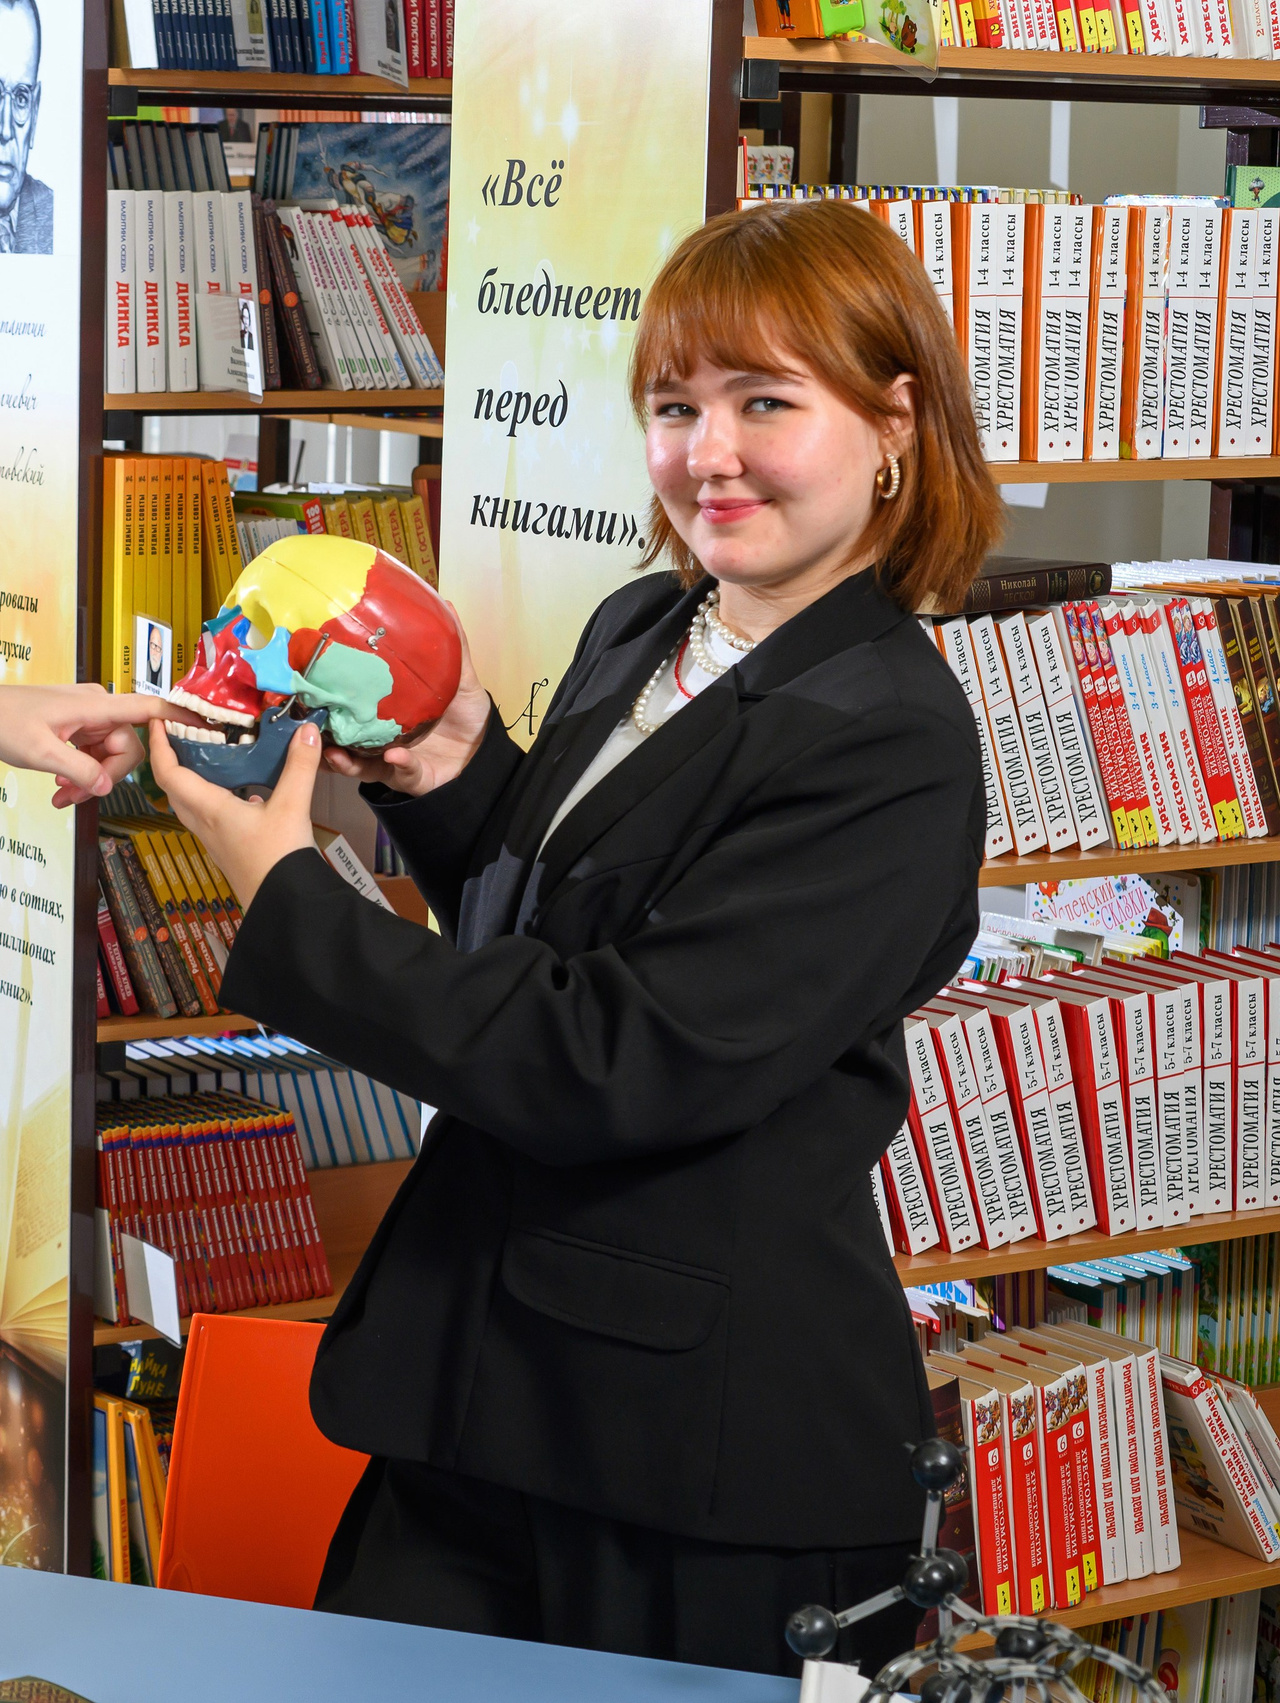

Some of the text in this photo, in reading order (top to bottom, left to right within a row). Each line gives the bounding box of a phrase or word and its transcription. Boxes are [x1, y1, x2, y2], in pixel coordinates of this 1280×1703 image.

[411, 9, 419, 66] ТОЛСТЯКА
[991, 24, 1000, 36] 2
[481, 159, 565, 208] «Всё
[1002, 213, 1016, 287] 1-4 классы
[1049, 215, 1062, 287] 1-4 классы
[1106, 217, 1119, 289] 1-4 классы
[1258, 218, 1272, 288] 1-4 классы
[116, 281, 129, 348] ДИНКА
[145, 281, 159, 347] ДИНКА
[176, 281, 190, 347] ДИНКА
[350, 244, 389, 335] ВОЛШЕБНОЕ СЛОВО
[477, 266, 641, 322] бледнеет
[996, 309, 1016, 432] ХРЕСТОМАТИЯ
[1043, 310, 1061, 432] ХРЕСТОМАТИЯ
[1098, 311, 1118, 431] ХРЕСТОМАТИЯ
[1251, 309, 1271, 428] ХРЕСТОМАТИЯ
[473, 380, 568, 438] перед
[306, 505, 319, 518] 100
[389, 509, 403, 553] ОСТЕРА
[414, 508, 427, 552] ОСТЕРА
[470, 492, 646, 549] книгами».
[1001, 577, 1037, 590] Николай
[980, 627, 1003, 696] 1-4 классы
[1041, 626, 1063, 694] 1-4 классы
[1122, 654, 1140, 710] 3-4 классы
[1161, 651, 1179, 706] 3-4 классы
[1188, 675, 1195, 685] 4
[1206, 648, 1217, 675] класс
[1091, 704, 1120, 798] ХРЕСТОМАТИЯ
[1194, 694, 1218, 775] ХРЕСТОМАТИЯ
[1221, 707, 1234, 749] ЧТЕНИЕ
[995, 714, 1036, 828] ХРЕСТОМАТИЯ
[1055, 711, 1098, 823] ХРЕСТОМАТИЯ
[7, 836, 47, 868] мысль,
[11, 889, 17, 903] в
[19, 889, 65, 922] сотнях,
[1101, 887, 1148, 930] СКАЗКИ
[0, 979, 34, 1006] книг».
[122, 977, 131, 997] ХЛЕБ
[1020, 1022, 1038, 1089] 5-7 классы
[1097, 1013, 1111, 1080] 5-7 классы
[1211, 995, 1222, 1060] 5-7 классы
[1246, 993, 1256, 1058] 5-7 классы
[915, 1038, 937, 1105] 5-7 классы
[1030, 1107, 1066, 1217] ХРЕСТОМАТИЯ
[1103, 1100, 1129, 1212] ХРЕСТОМАТИЯ
[1209, 1081, 1226, 1190] ХРЕСТОМАТИЯ
[1243, 1080, 1258, 1189] ХРЕСТОМАТИЯ
[929, 1121, 970, 1231] ХРЕСТОМАТИЯ
[990, 1450, 997, 1463] 6
[1205, 1415, 1223, 1448] ШКОЛЕ
[1102, 1481, 1112, 1499] ДЛЯ
[1155, 1469, 1166, 1486] ДЛЯ
[1229, 1445, 1255, 1496] ШКОЛЬНЫЕ
[996, 1475, 1008, 1572] ХРЕСТОМАТИЯ
[1248, 1508, 1272, 1554] СМЕШНЫЕ
